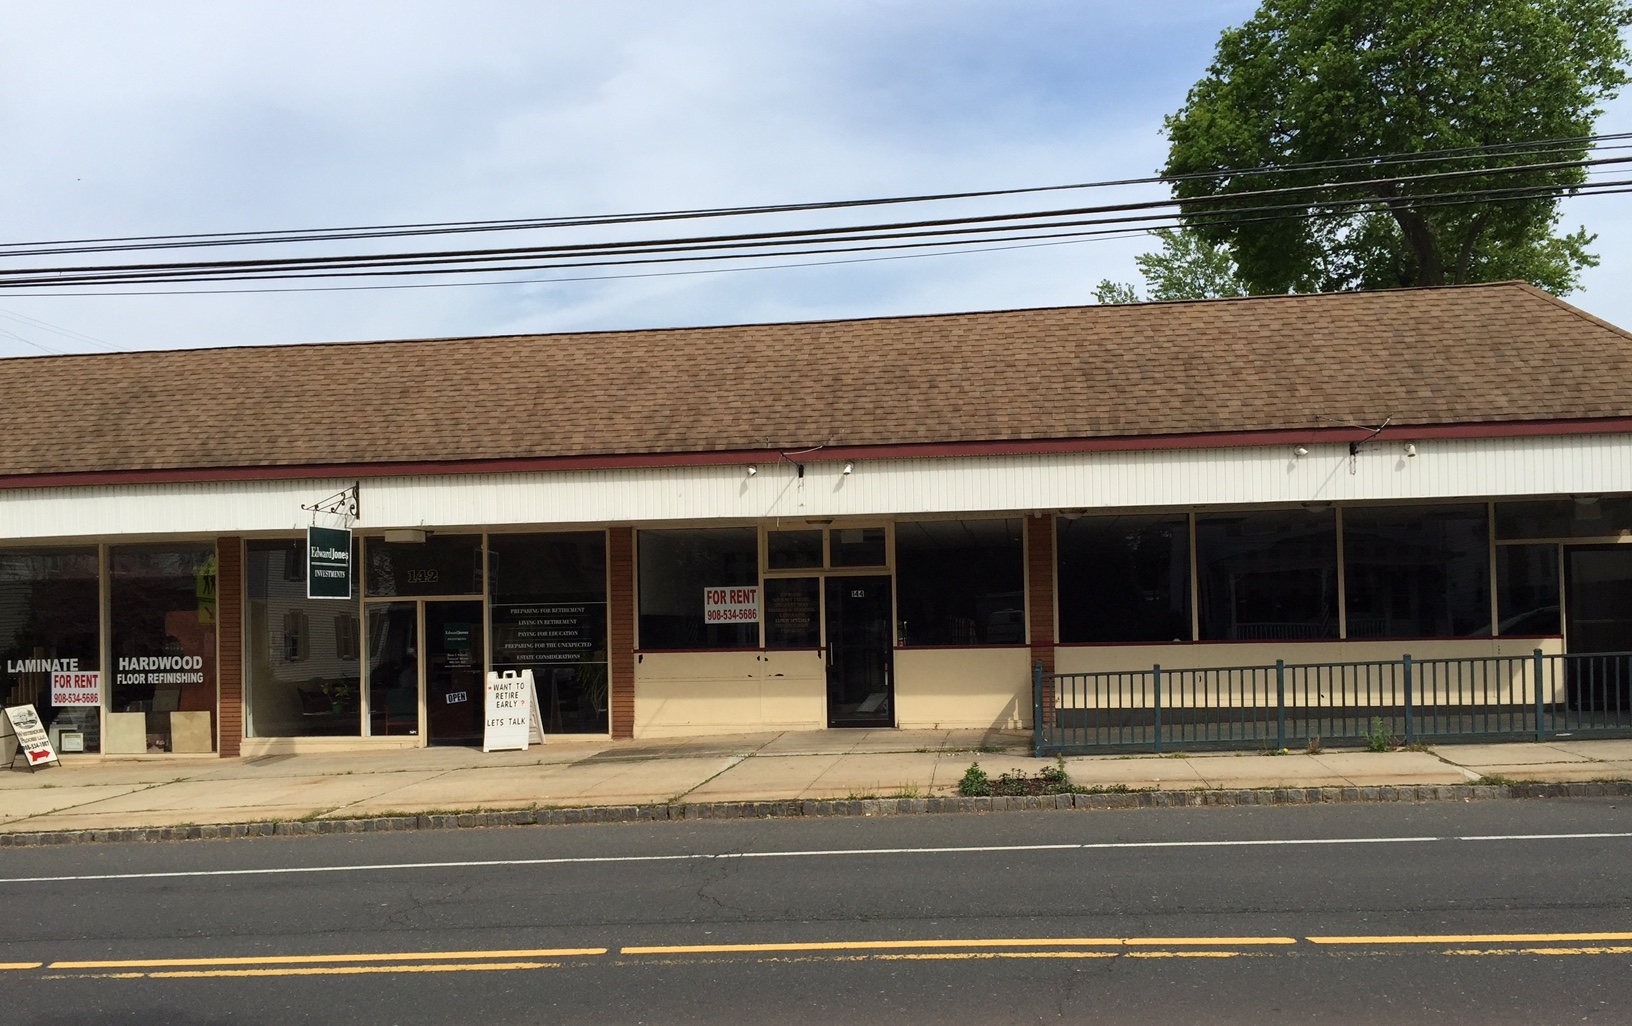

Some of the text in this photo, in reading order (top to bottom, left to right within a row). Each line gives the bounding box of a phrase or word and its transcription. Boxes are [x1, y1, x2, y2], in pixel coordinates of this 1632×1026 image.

[311, 546, 348, 560] EdwardJones
[315, 570, 345, 578] INVESTMENTS
[408, 569, 439, 583] 142
[707, 589, 756, 604] FOR RENT
[707, 609, 756, 620] 908-534-5686
[7, 658, 78, 673] LAMINATE
[119, 656, 203, 670] HARDWOOD
[54, 674, 98, 688] FOR RENT
[117, 672, 203, 684] FLOOR REFINISHING
[54, 693, 98, 703] 908-534-5686
[448, 692, 466, 703] OPEN
